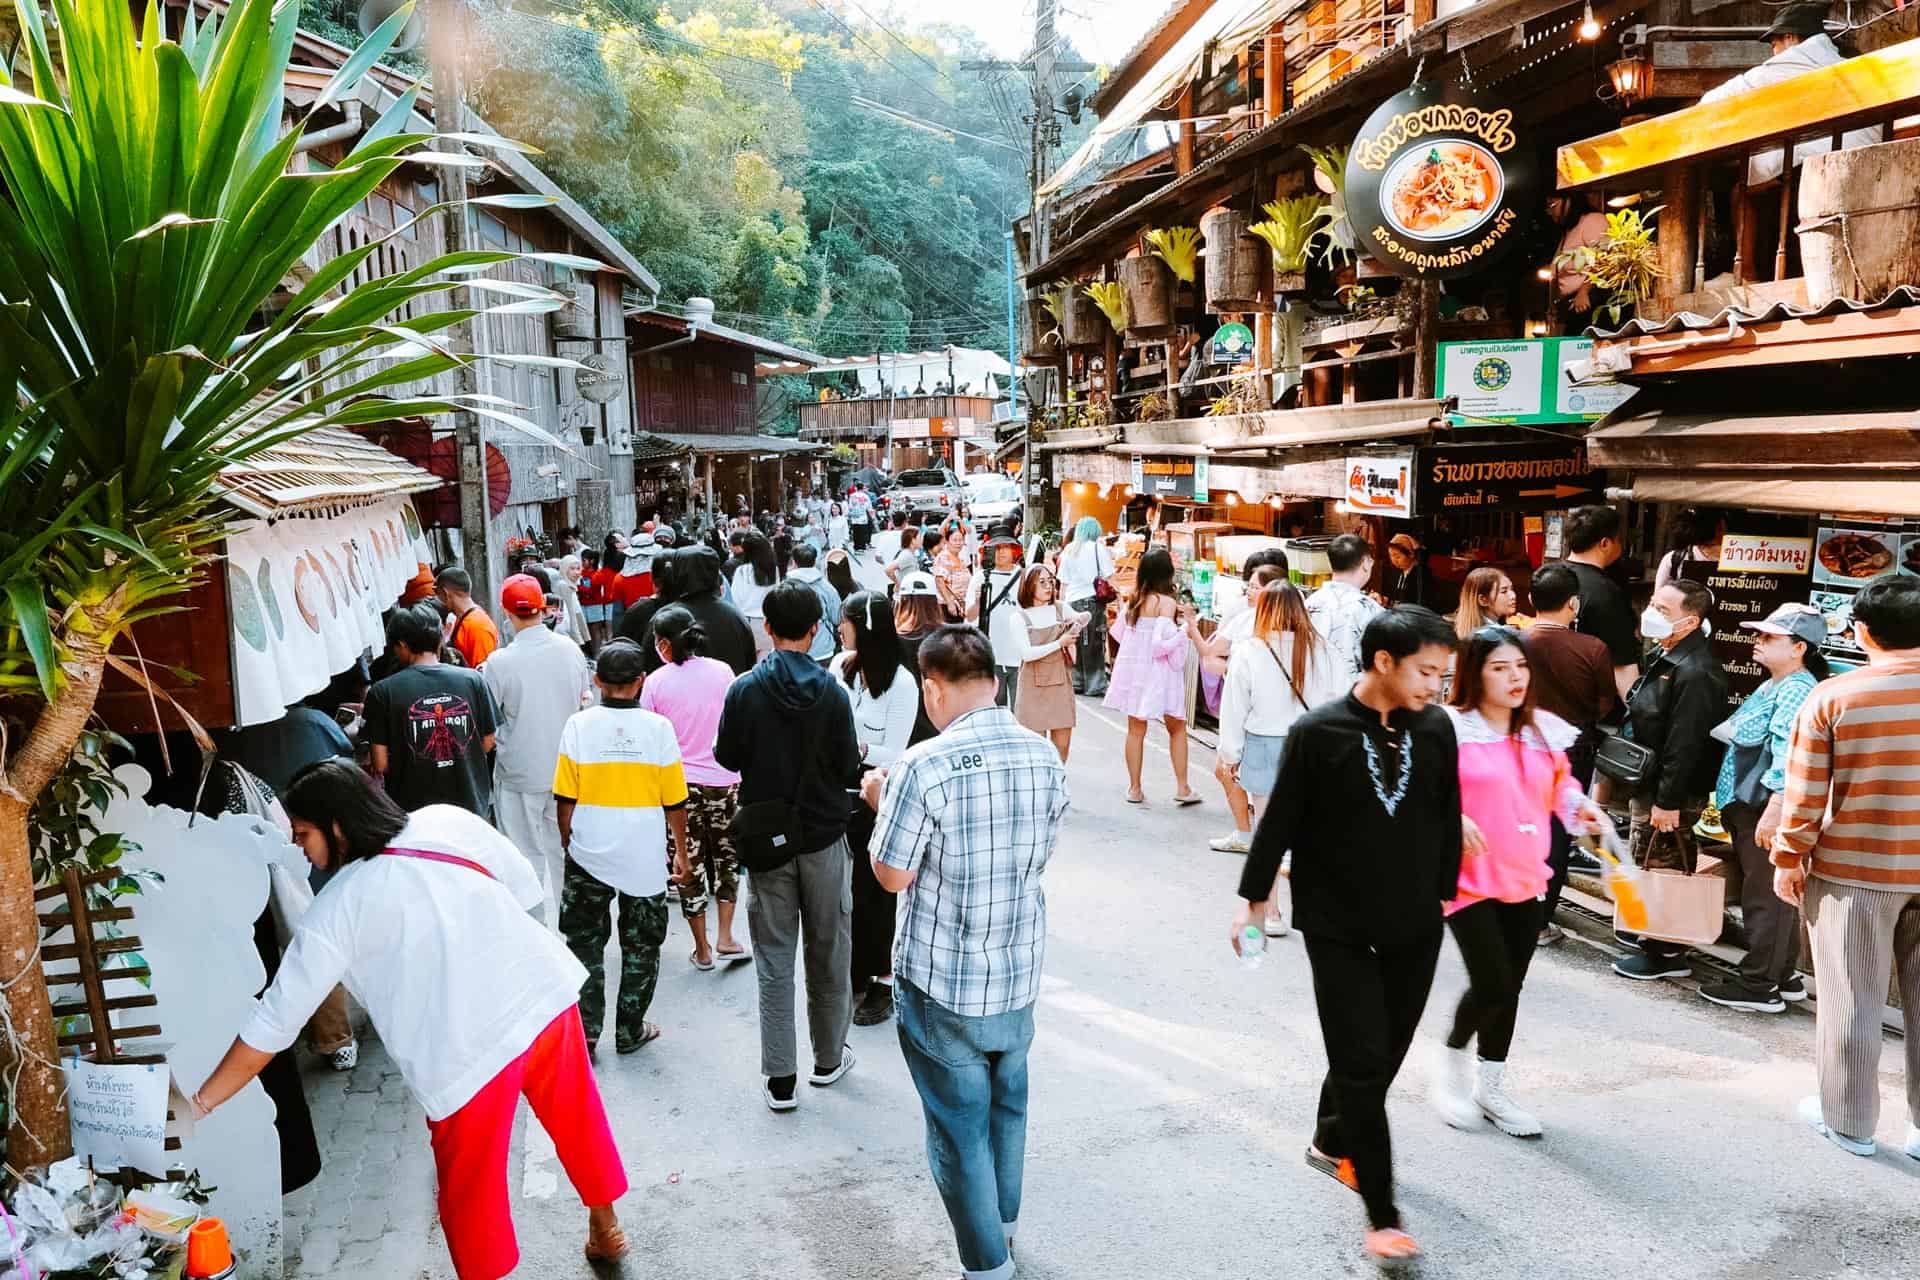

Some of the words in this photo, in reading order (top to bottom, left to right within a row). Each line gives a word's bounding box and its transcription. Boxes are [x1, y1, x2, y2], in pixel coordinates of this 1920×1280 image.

[1355, 104, 1516, 170] ข้าวซอยกลอยใจ
[1372, 208, 1517, 273] สะอาดถูกหลักอนามัย
[1724, 540, 1807, 571] ข้าวต้มหมู
[950, 754, 983, 771] Lee
